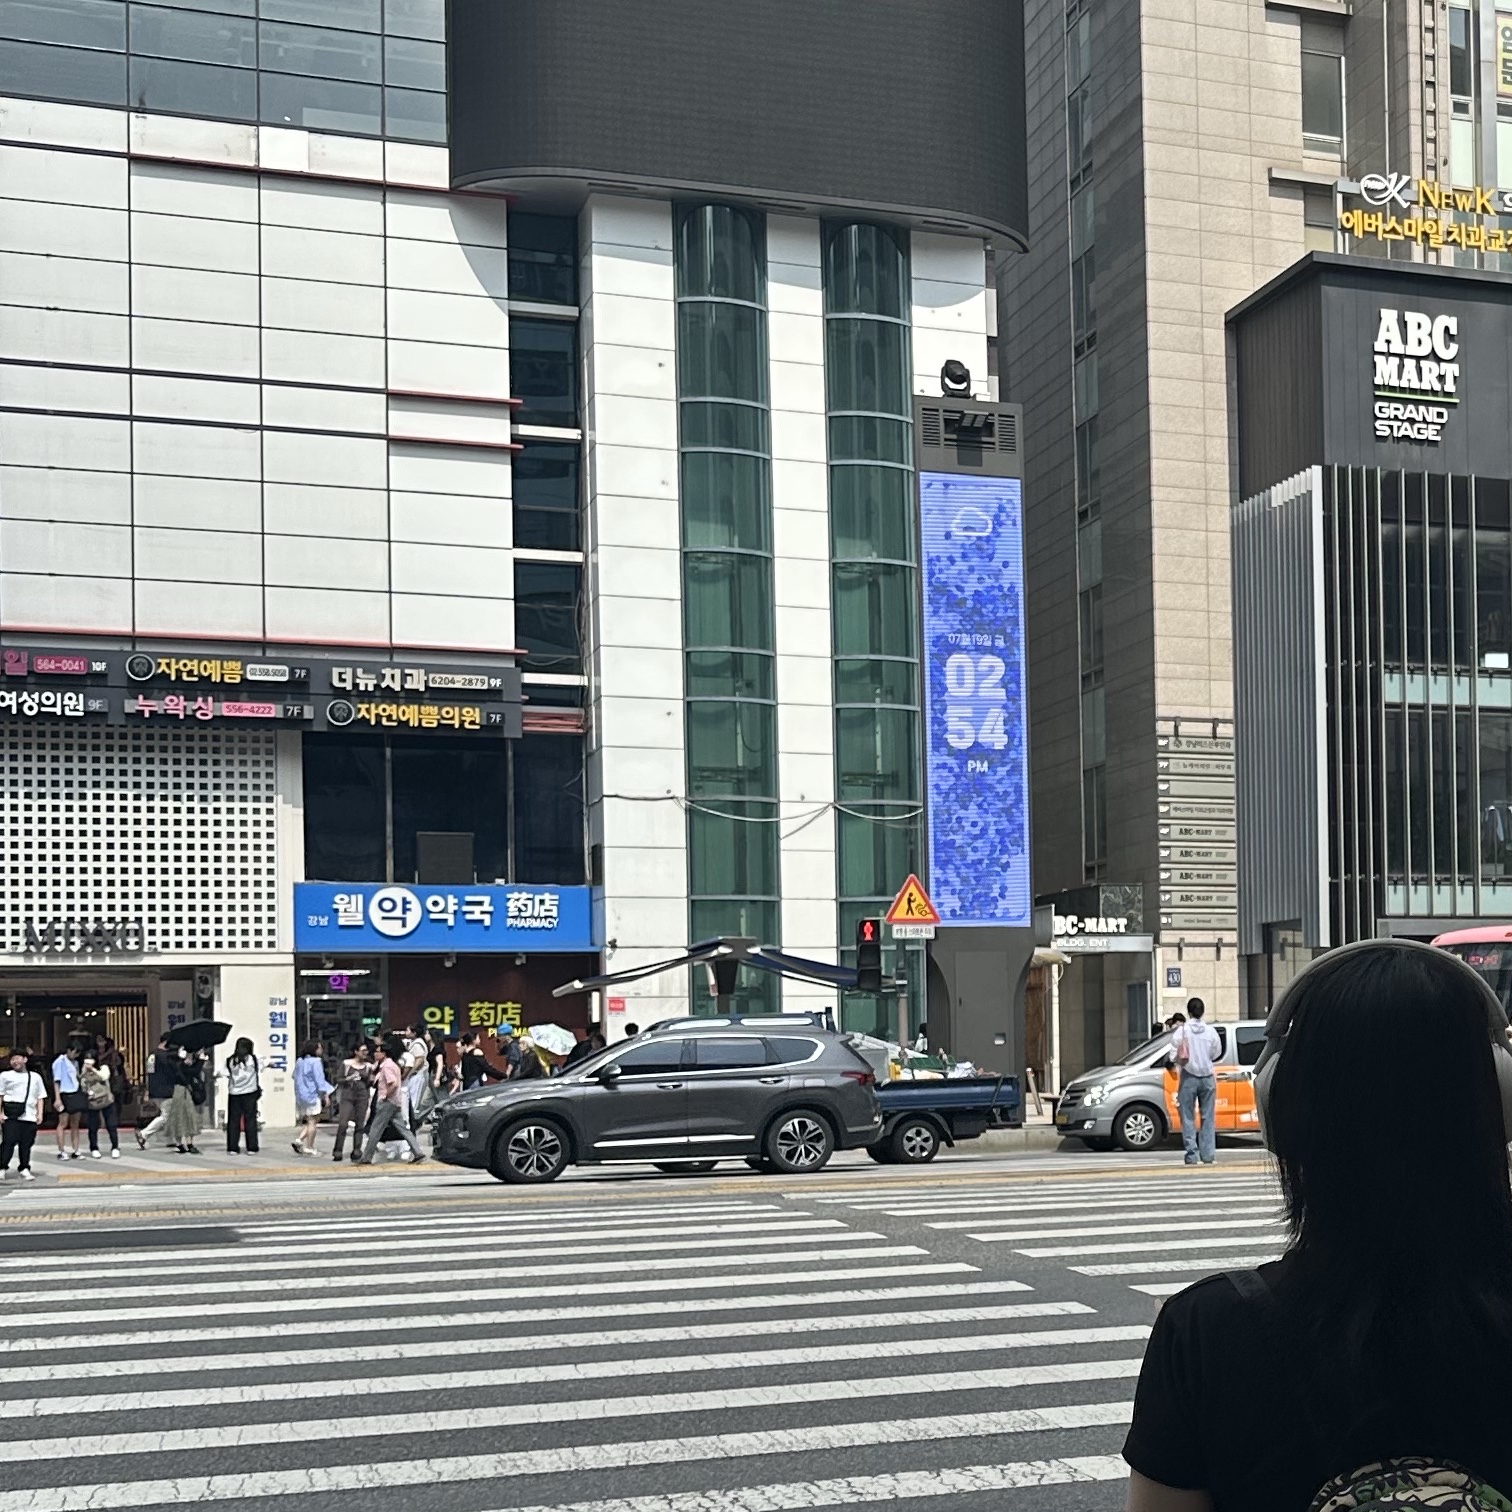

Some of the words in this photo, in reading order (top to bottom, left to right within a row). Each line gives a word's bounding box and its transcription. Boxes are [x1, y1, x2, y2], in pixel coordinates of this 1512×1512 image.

[1342, 208, 1443, 247] 에버스마일
[1374, 308, 1459, 360] ABC
[1374, 355, 1460, 393] MART
[1374, 401, 1449, 424] GRAND
[1374, 420, 1442, 441] STAGE
[157, 657, 243, 683] 자연예쁨
[294, 668, 307, 679] 7F
[430, 674, 486, 688] 6204-2879
[489, 678, 502, 688] 9F
[946, 654, 1007, 697] 02
[88, 699, 104, 711] 9F
[286, 705, 301, 717] 7F
[357, 702, 481, 730] 자연예쁨의원
[489, 714, 503, 724] 7F
[946, 705, 1009, 750] 54
[967, 760, 989, 773] PM
[308, 915, 329, 926] 강남
[333, 893, 365, 926] 웰
[506, 892, 560, 917] 药店
[24, 920, 144, 951] MIXXO
[506, 917, 559, 929] PHARMACY
[329, 973, 350, 992] 약
[423, 1006, 455, 1035] 약
[469, 1001, 523, 1027] 药店
